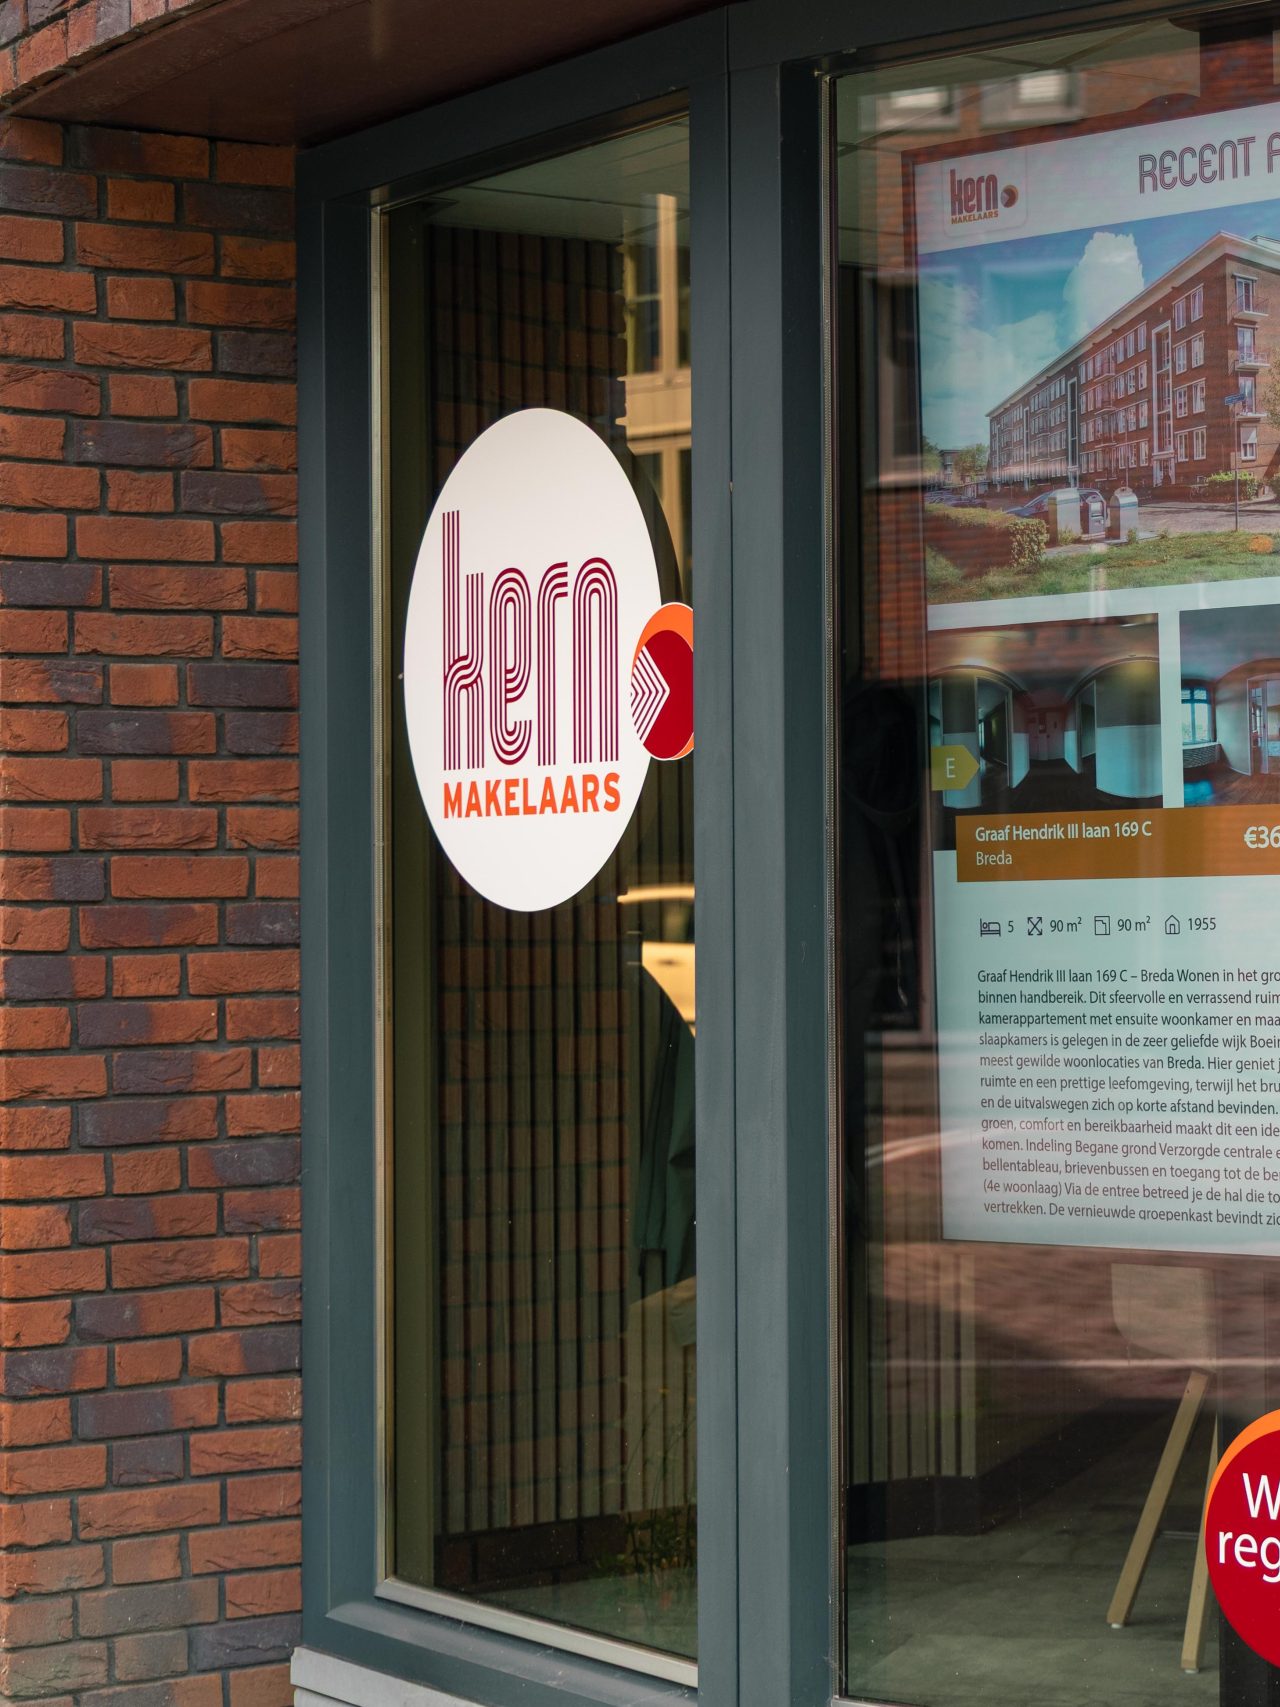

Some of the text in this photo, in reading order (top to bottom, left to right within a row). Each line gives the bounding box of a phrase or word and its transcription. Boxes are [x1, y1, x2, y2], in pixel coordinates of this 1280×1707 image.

[1138, 136, 1256, 194] RECENT
[950, 169, 998, 216] kern
[951, 210, 999, 224] MAKELAARS
[442, 510, 619, 770] kern
[945, 758, 956, 778] E
[443, 772, 621, 819] MAKELAARS
[975, 821, 1152, 841] Graaf Hendrik III laan 169 C
[976, 850, 1013, 865] Breda
[1007, 920, 1014, 933] 5
[1050, 919, 1064, 933] 90
[1117, 918, 1132, 932] 90
[1187, 917, 1217, 931] 1955
[978, 968, 1007, 984] Graaf
[1009, 968, 1054, 983] Hendrik
[1068, 968, 1093, 983] laan
[1096, 968, 1117, 983] 169
[1119, 968, 1128, 983] C
[1141, 968, 1175, 983] Breda
[1176, 968, 1220, 983] Wonen
[1238, 967, 1258, 983] het
[978, 989, 1017, 1004] binnen
[1020, 989, 1087, 1004] handbereik.
[1089, 989, 1107, 1005] Dit
[1109, 989, 1166, 1005] sfeervolle
[1168, 993, 1184, 1005] en
[1186, 989, 1252, 1005] verrassend
[978, 1010, 1087, 1029] kamerappartement
[1090, 1013, 1113, 1026] met
[1115, 1011, 1159, 1026] ensuite
[1160, 1011, 1234, 1027] woonkamer
[1236, 1016, 1252, 1027] en
[979, 1031, 1048, 1049] slaapkamers
[1062, 1031, 1109, 1050] gelegen
[1125, 1032, 1141, 1047] de
[1142, 1036, 1168, 1048] zeer
[1170, 1032, 1219, 1051] geliefde
[1222, 1033, 1247, 1051] wijk
[980, 1054, 1013, 1067] meest
[1016, 1052, 1061, 1071] gewilde
[1063, 1053, 1140, 1069] woonlocaties
[1142, 1058, 1164, 1070] van
[1167, 1054, 1205, 1070] Breda.
[1208, 1055, 1233, 1071] Hier
[1235, 1055, 1275, 1074] geniet
[980, 1073, 1017, 1089] ruimte
[1019, 1078, 1034, 1089] en
[1036, 1078, 1057, 1089] een
[1060, 1074, 1106, 1093] prettige
[1108, 1075, 1193, 1095] leefomgeving,
[1195, 1077, 1234, 1095] terwijl
[1236, 1077, 1257, 1093] het
[980, 1097, 995, 1109] en
[997, 1094, 1012, 1109] de
[1014, 1094, 1089, 1114] uitvalswegen
[1092, 1096, 1115, 1112] zich
[1118, 1101, 1134, 1115] op
[1136, 1097, 1168, 1113] korte
[1170, 1098, 1215, 1114] afstand
[1217, 1099, 1279, 1115] bevinden.
[981, 1120, 1017, 1134] groen,
[1020, 1116, 1065, 1133] comfort
[1067, 1122, 1082, 1133] en
[1084, 1118, 1173, 1135] bereikbaarheid
[1175, 1120, 1213, 1136] maakt
[1215, 1121, 1233, 1137] dit
[1235, 1125, 1258, 1137] een
[982, 1136, 1023, 1153] komen.
[1026, 1137, 1073, 1157] Indeling
[1075, 1139, 1119, 1158] Begane
[1121, 1140, 1157, 1159] grond
[1158, 1141, 1221, 1161] Verzorgde
[1223, 1143, 1273, 1160] centrale
[982, 1156, 1062, 1176] bellentableau,
[1064, 1159, 1149, 1177] brievenbussen
[1152, 1166, 1167, 1178] en
[1170, 1165, 1221, 1183] toegang
[1223, 1167, 1242, 1181] tot
[1244, 1166, 1260, 1181] de
[984, 1177, 1001, 1196] (4e
[1003, 1178, 1062, 1198] woonlaag)
[1064, 1181, 1082, 1196] Via
[1084, 1181, 1099, 1197] de
[1102, 1184, 1140, 1199] entree
[1142, 1184, 1189, 1201] betreed
[1192, 1186, 1203, 1204] je
[1206, 1186, 1221, 1202] de
[1224, 1187, 1243, 1203] hal
[1245, 1188, 1265, 1204] die
[984, 1198, 1047, 1216] vertrekken.
[1049, 1201, 1065, 1217] De
[1067, 1202, 1136, 1220] vernieuwde
[1216, 1208, 1263, 1225] bevindt
